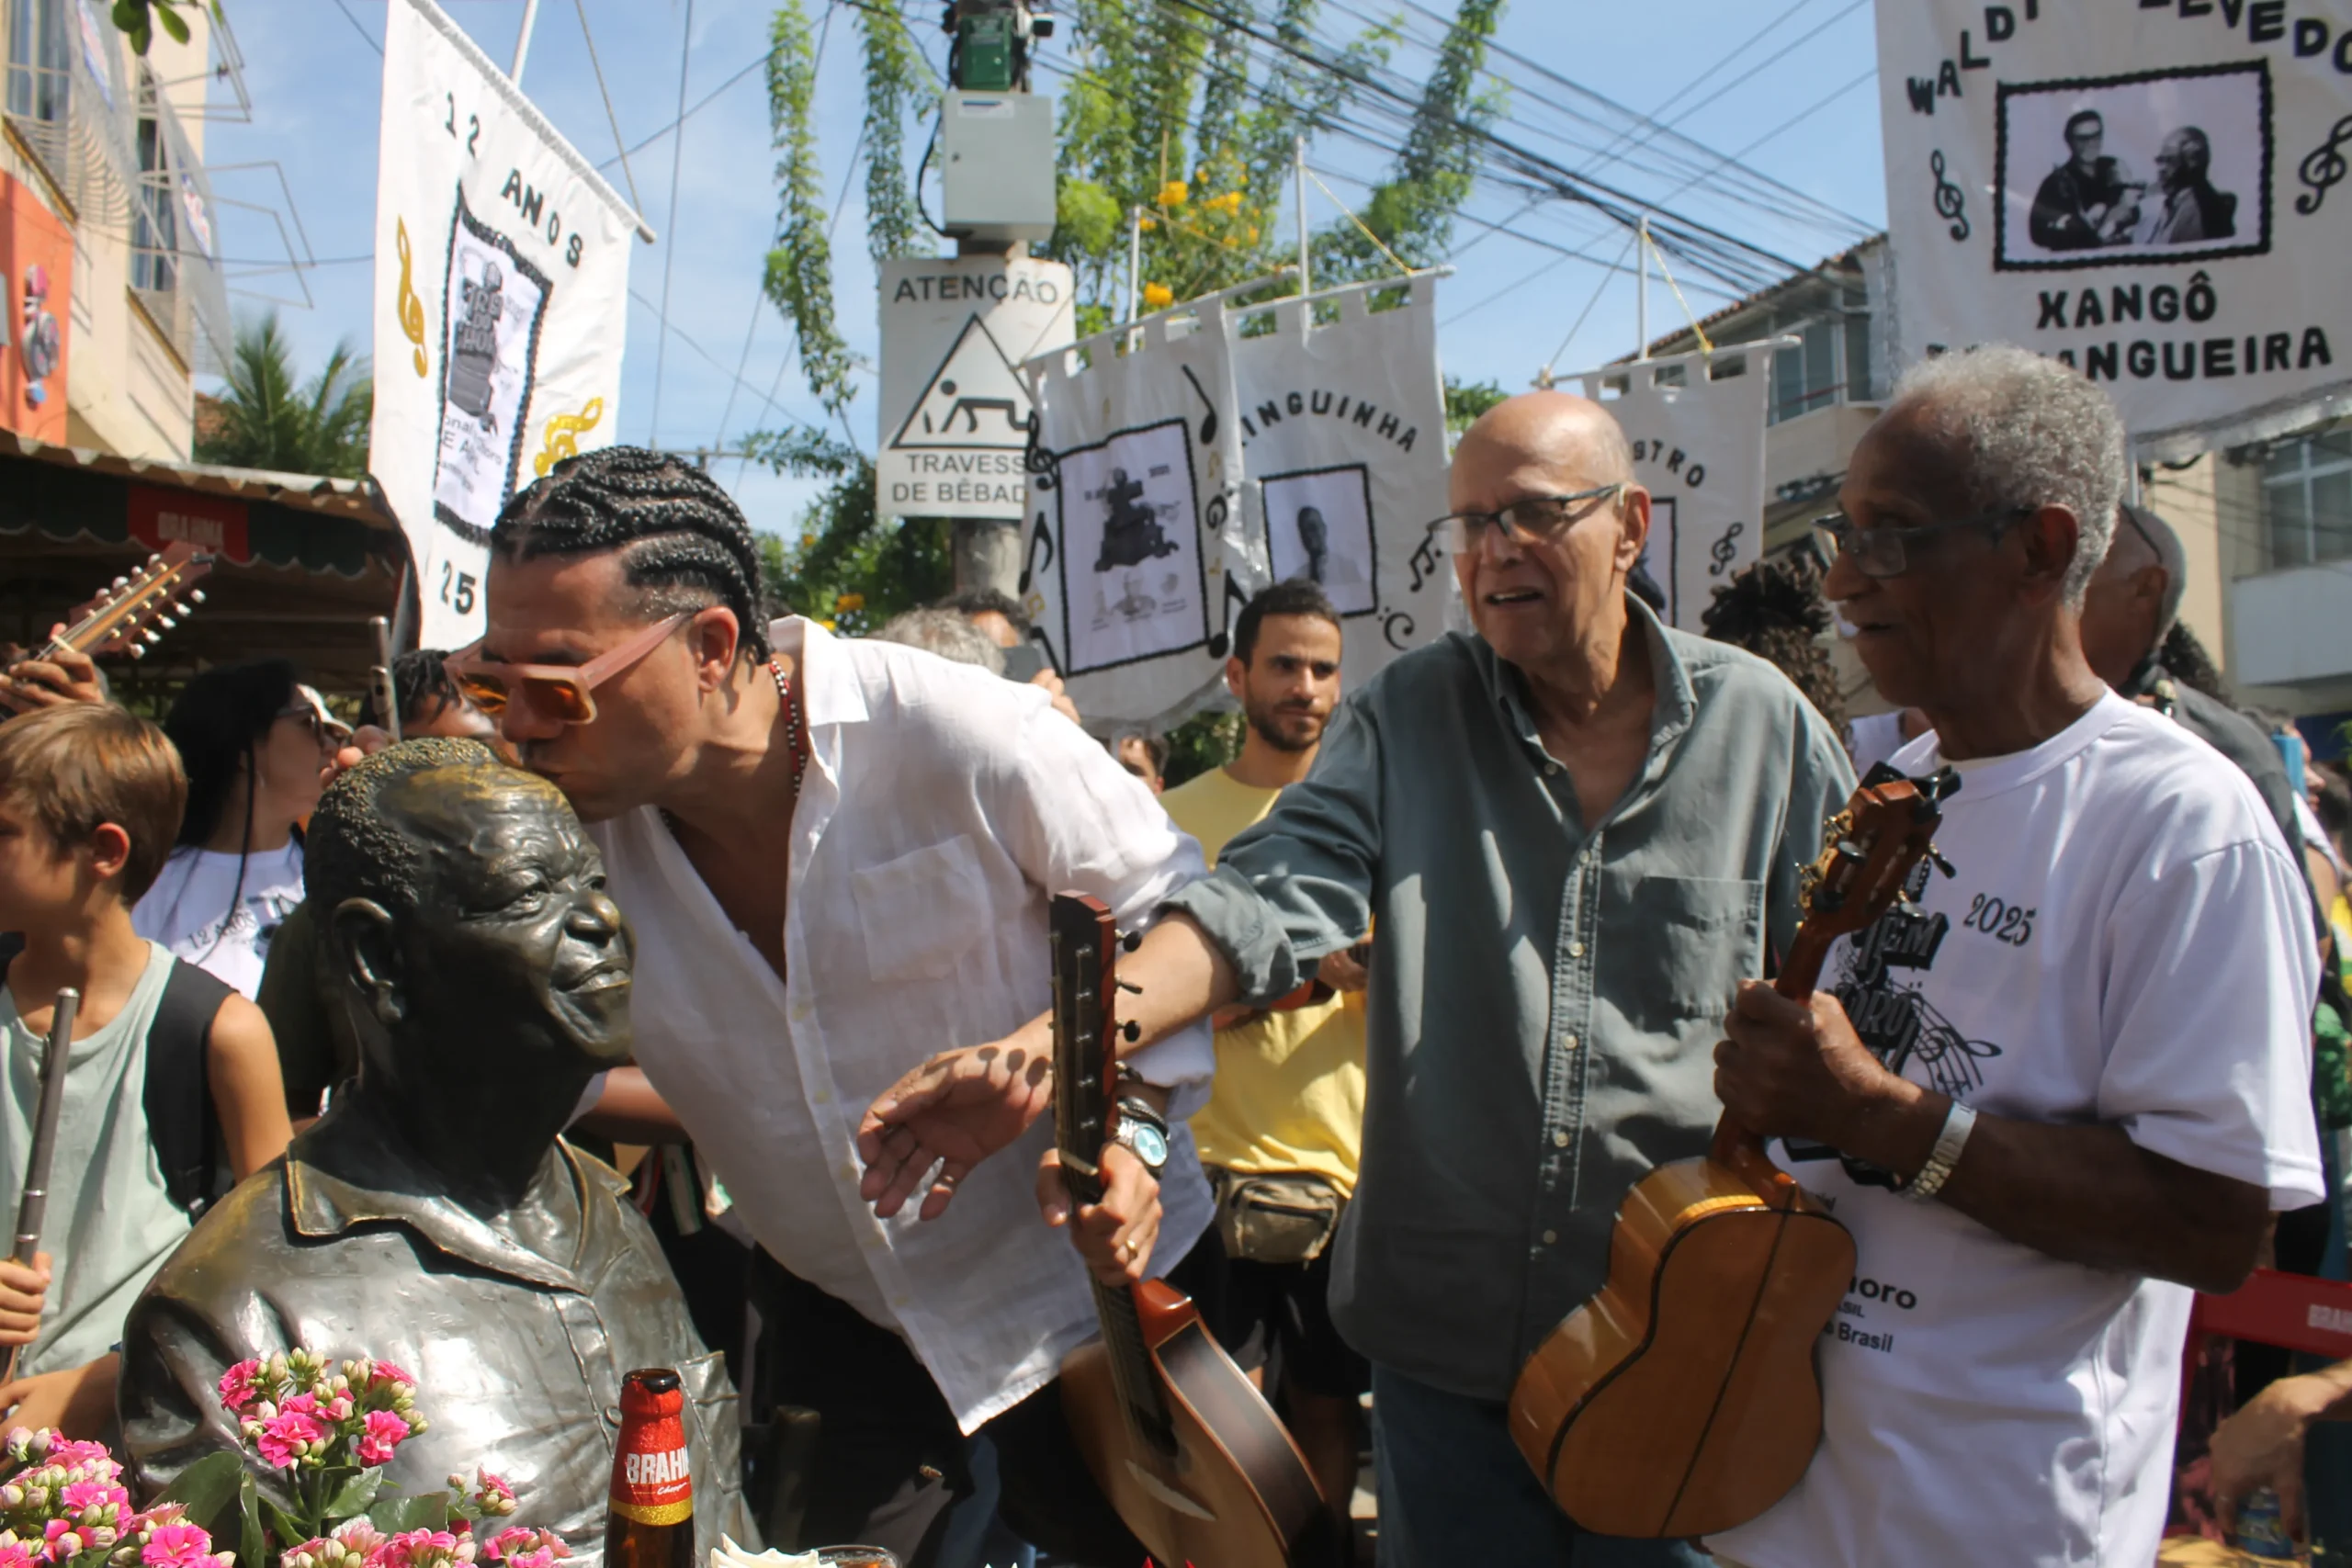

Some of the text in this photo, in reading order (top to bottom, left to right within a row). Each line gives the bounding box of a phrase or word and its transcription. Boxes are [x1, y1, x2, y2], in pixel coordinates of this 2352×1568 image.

[446, 92, 583, 268] 12 ANOS
[894, 271, 1058, 305] ATENÇÃO
[2037, 270, 2217, 329] XANGÔ
[1241, 389, 1418, 453] INGUINHA
[892, 482, 927, 503] DE
[1962, 892, 2037, 947] 2025
[1838, 1322, 1894, 1353] Brasil
